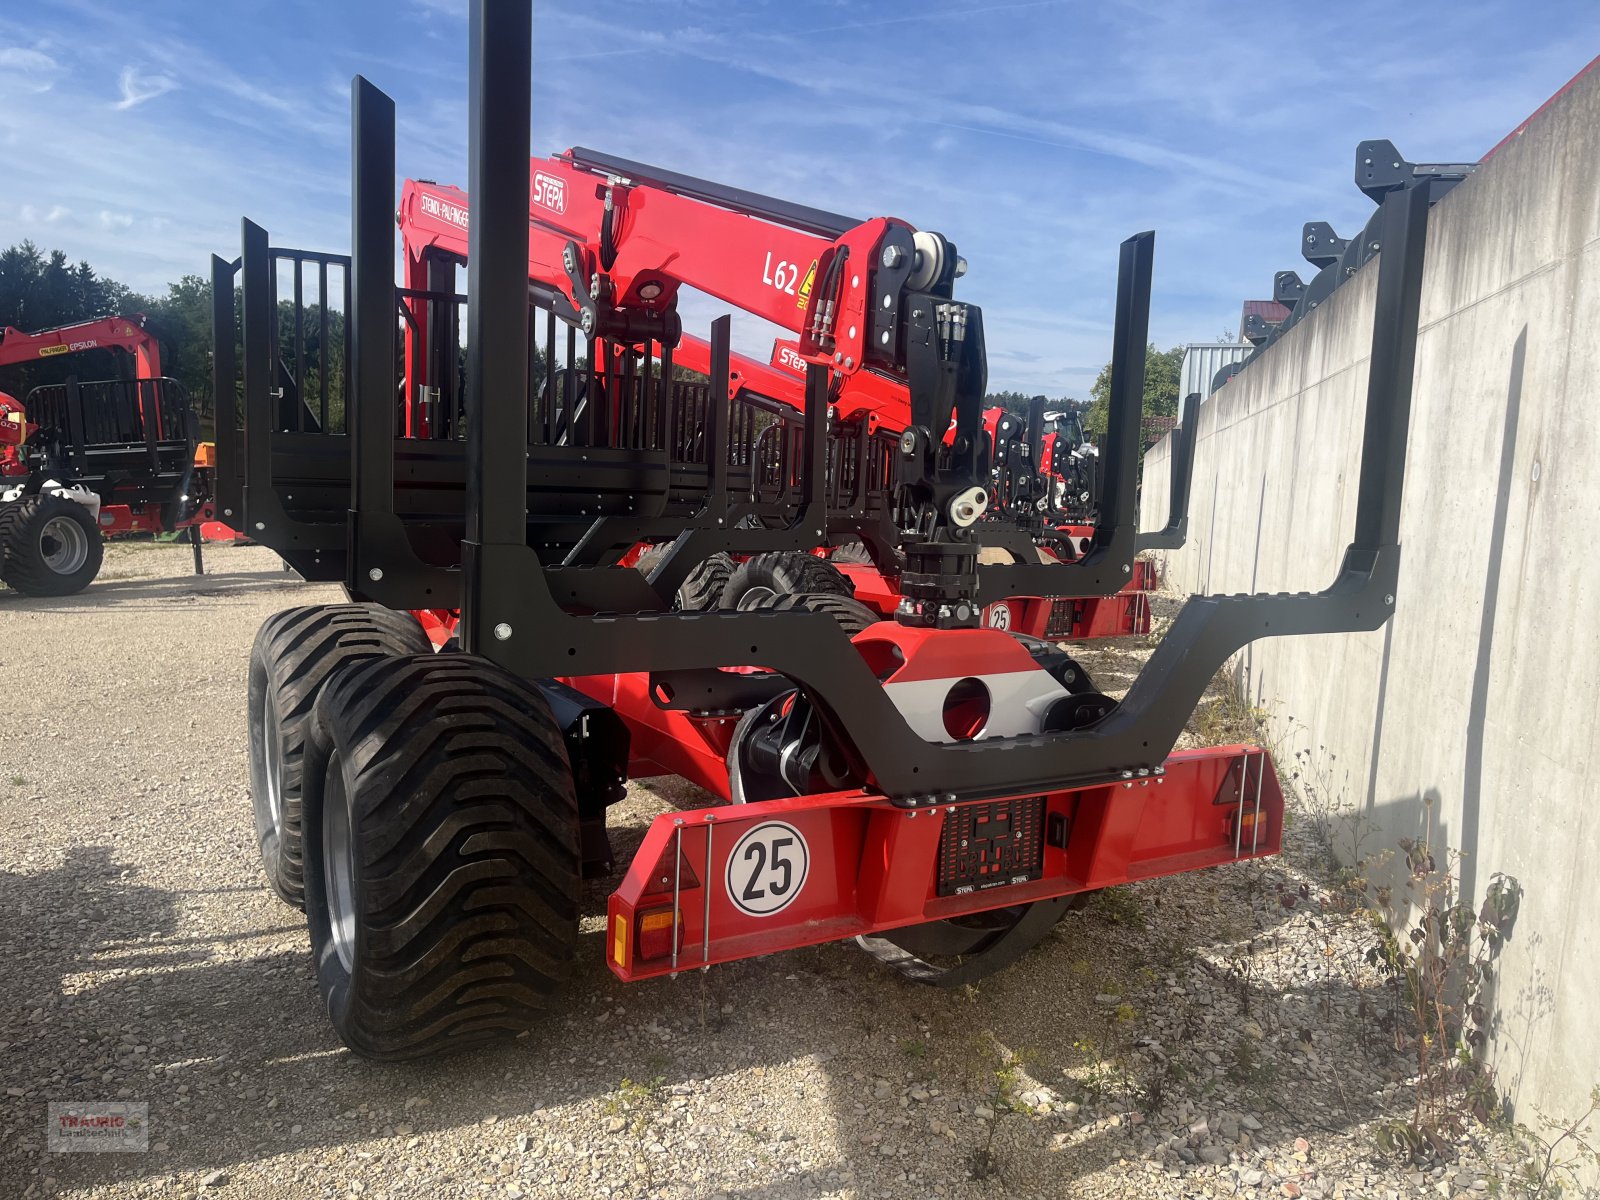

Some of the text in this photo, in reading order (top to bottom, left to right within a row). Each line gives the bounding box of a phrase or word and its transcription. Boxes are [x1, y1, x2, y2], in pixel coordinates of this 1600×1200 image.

[534, 173, 564, 212] STEPA
[763, 251, 798, 296] L62
[70, 340, 97, 351] EPSILON
[994, 610, 1007, 629] 25
[743, 838, 793, 900] 25
[956, 886, 973, 894] STEPA
